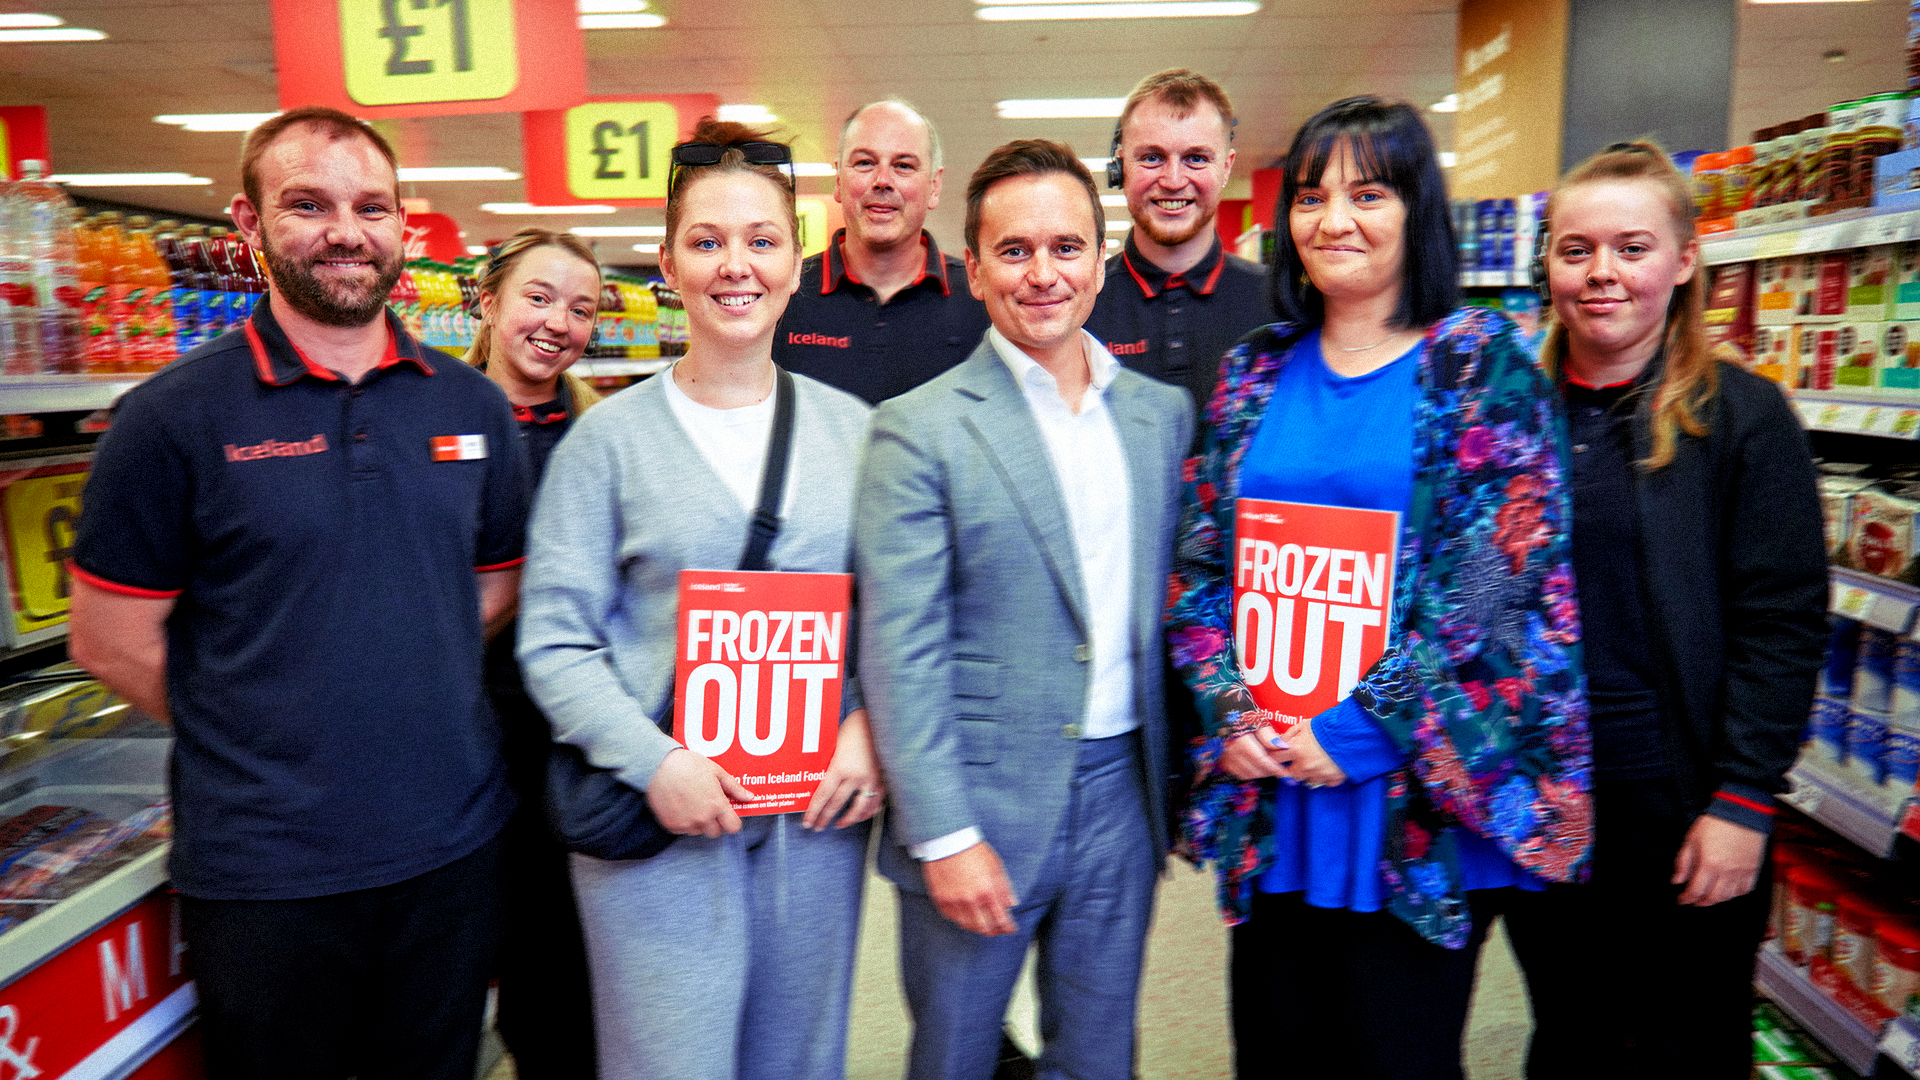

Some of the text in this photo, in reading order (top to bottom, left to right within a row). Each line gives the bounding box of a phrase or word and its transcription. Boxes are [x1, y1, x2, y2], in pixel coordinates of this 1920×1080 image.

[379, 0, 472, 75] £1
[591, 120, 649, 179] £1
[788, 332, 851, 349] Iceland
[1104, 339, 1149, 355] land
[224, 434, 328, 463] Iceland
[1237, 538, 1387, 608] FROZEN
[687, 609, 843, 662] FROZEN
[1235, 591, 1382, 703] OUT
[683, 663, 838, 758] OUT
[1275, 710, 1298, 725] from
[742, 773, 766, 785] from
[767, 771, 802, 784] Iceland
[803, 769, 827, 782] Food
